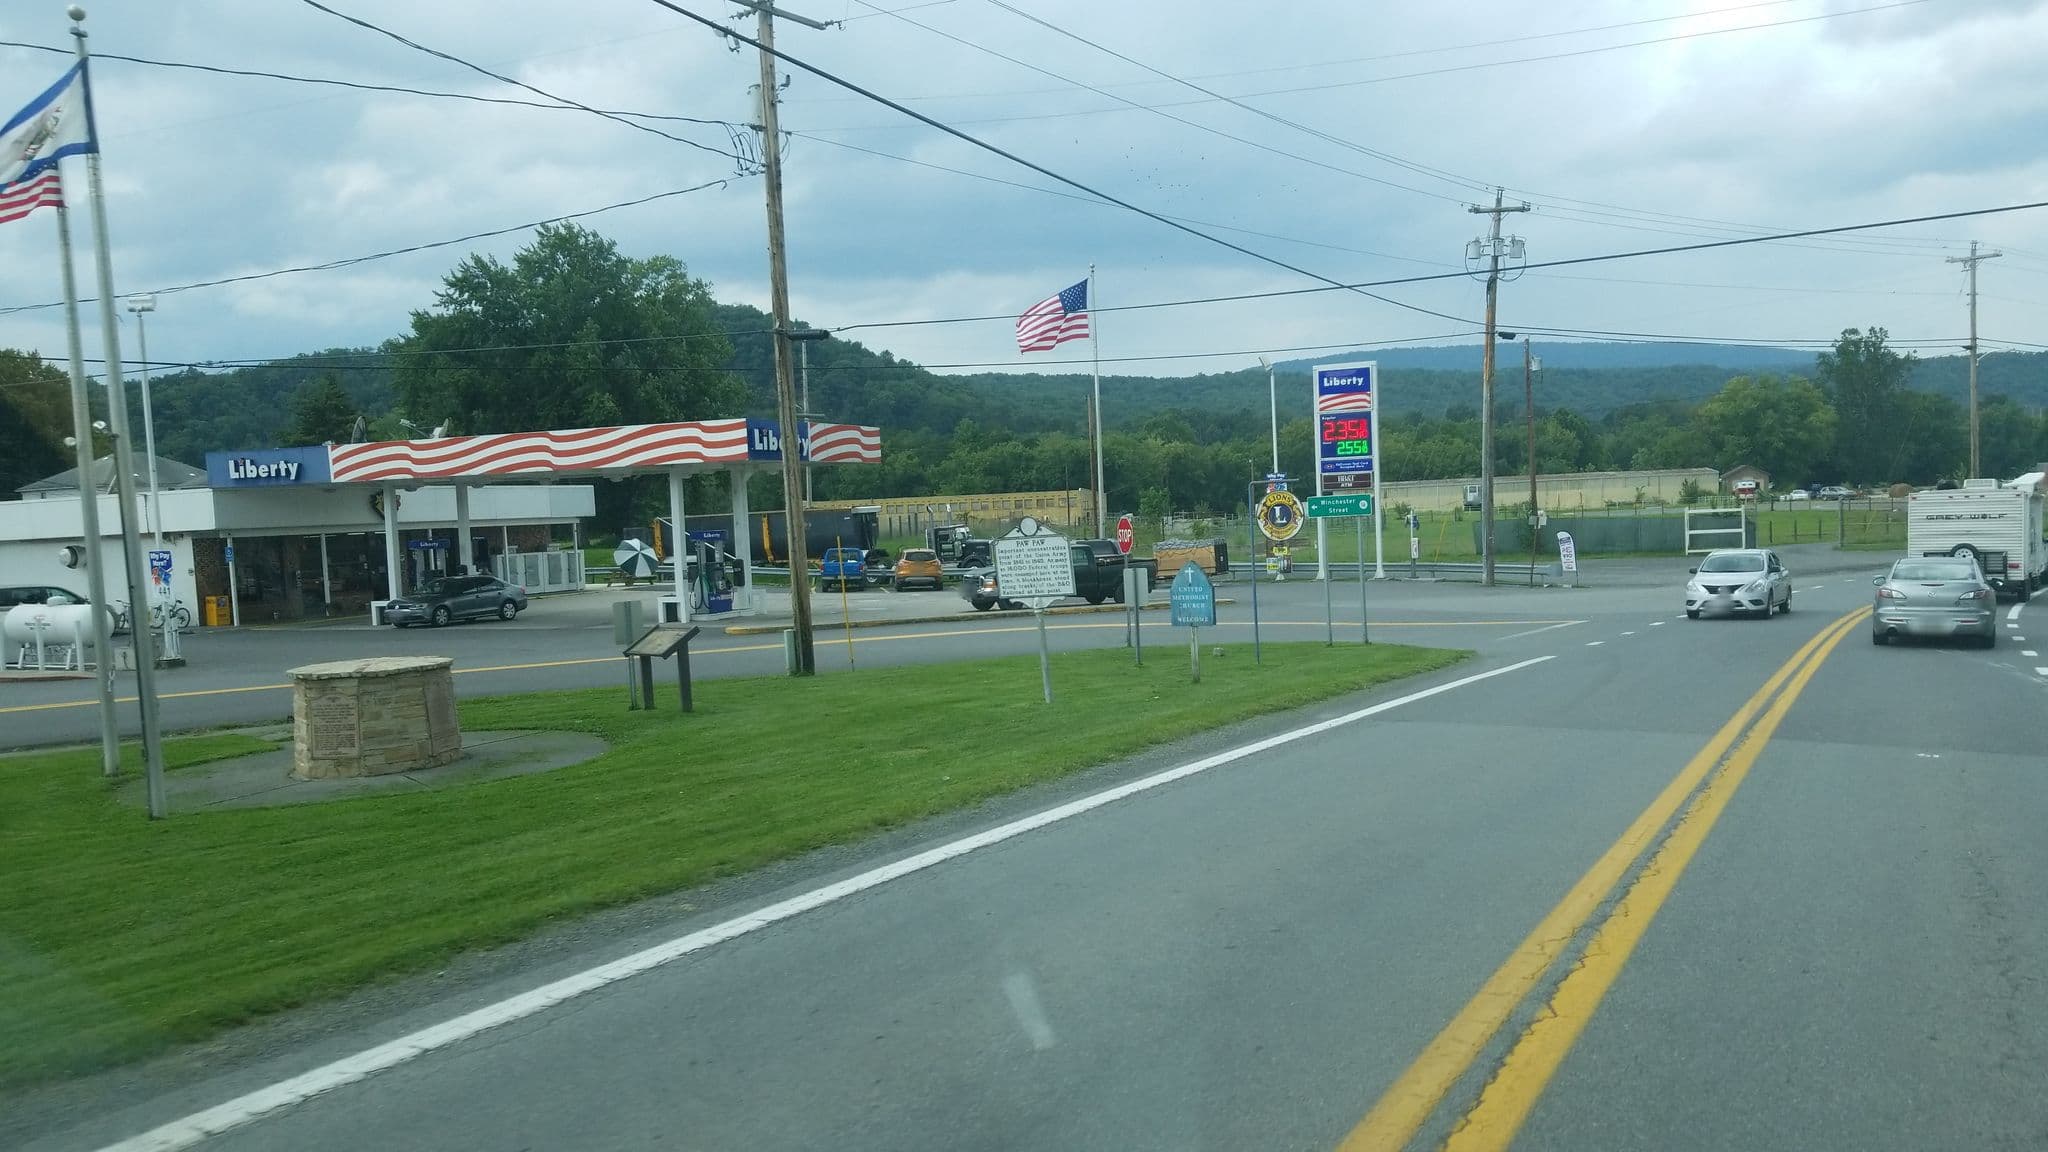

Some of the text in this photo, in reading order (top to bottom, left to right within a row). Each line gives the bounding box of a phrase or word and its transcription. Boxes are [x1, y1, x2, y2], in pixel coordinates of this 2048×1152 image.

[1323, 376, 1364, 386] Liberty
[754, 428, 808, 456] Liby
[228, 458, 299, 480] Liberty
[1268, 494, 1292, 504] LIONS
[1274, 506, 1287, 524] L
[1119, 529, 1131, 542] STOP
